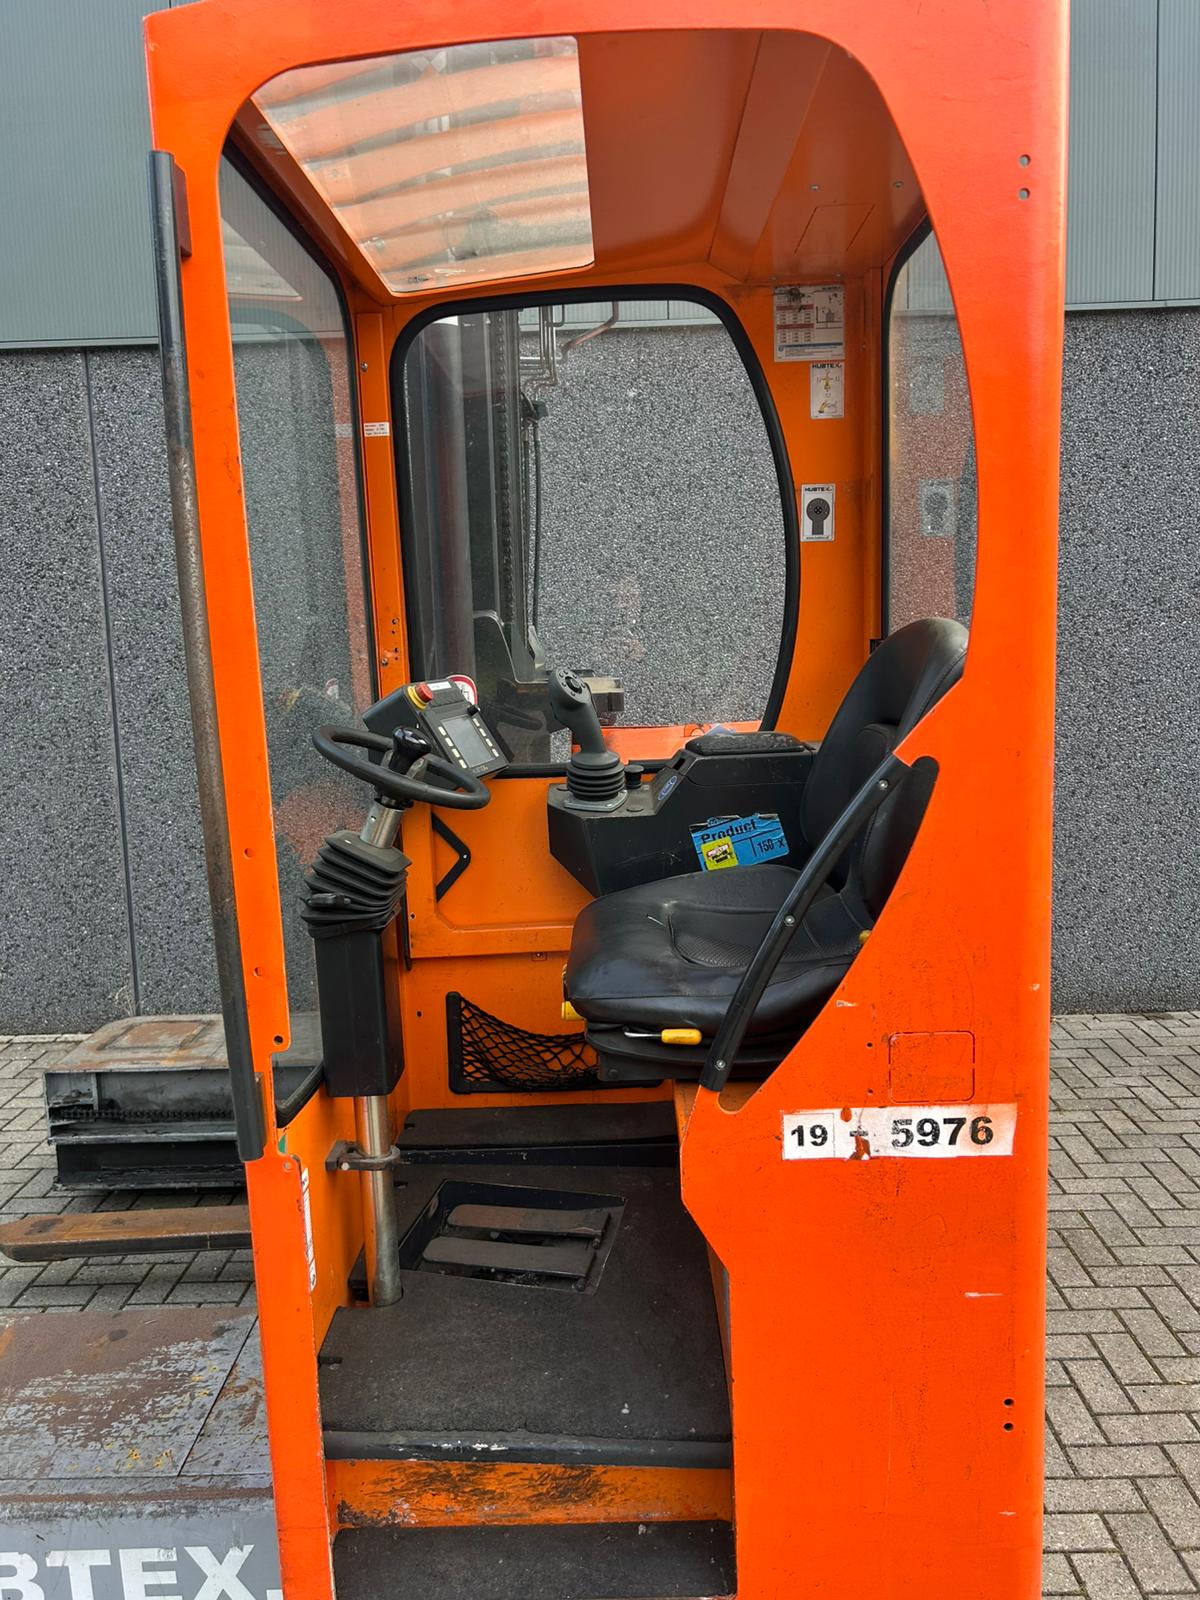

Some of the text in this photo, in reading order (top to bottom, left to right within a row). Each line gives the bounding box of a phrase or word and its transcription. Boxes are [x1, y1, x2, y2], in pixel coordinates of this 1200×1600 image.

[701, 819, 757, 844] Product
[757, 838, 775, 853] 150
[791, 1125, 829, 1147] 19
[891, 1116, 994, 1148] 5976
